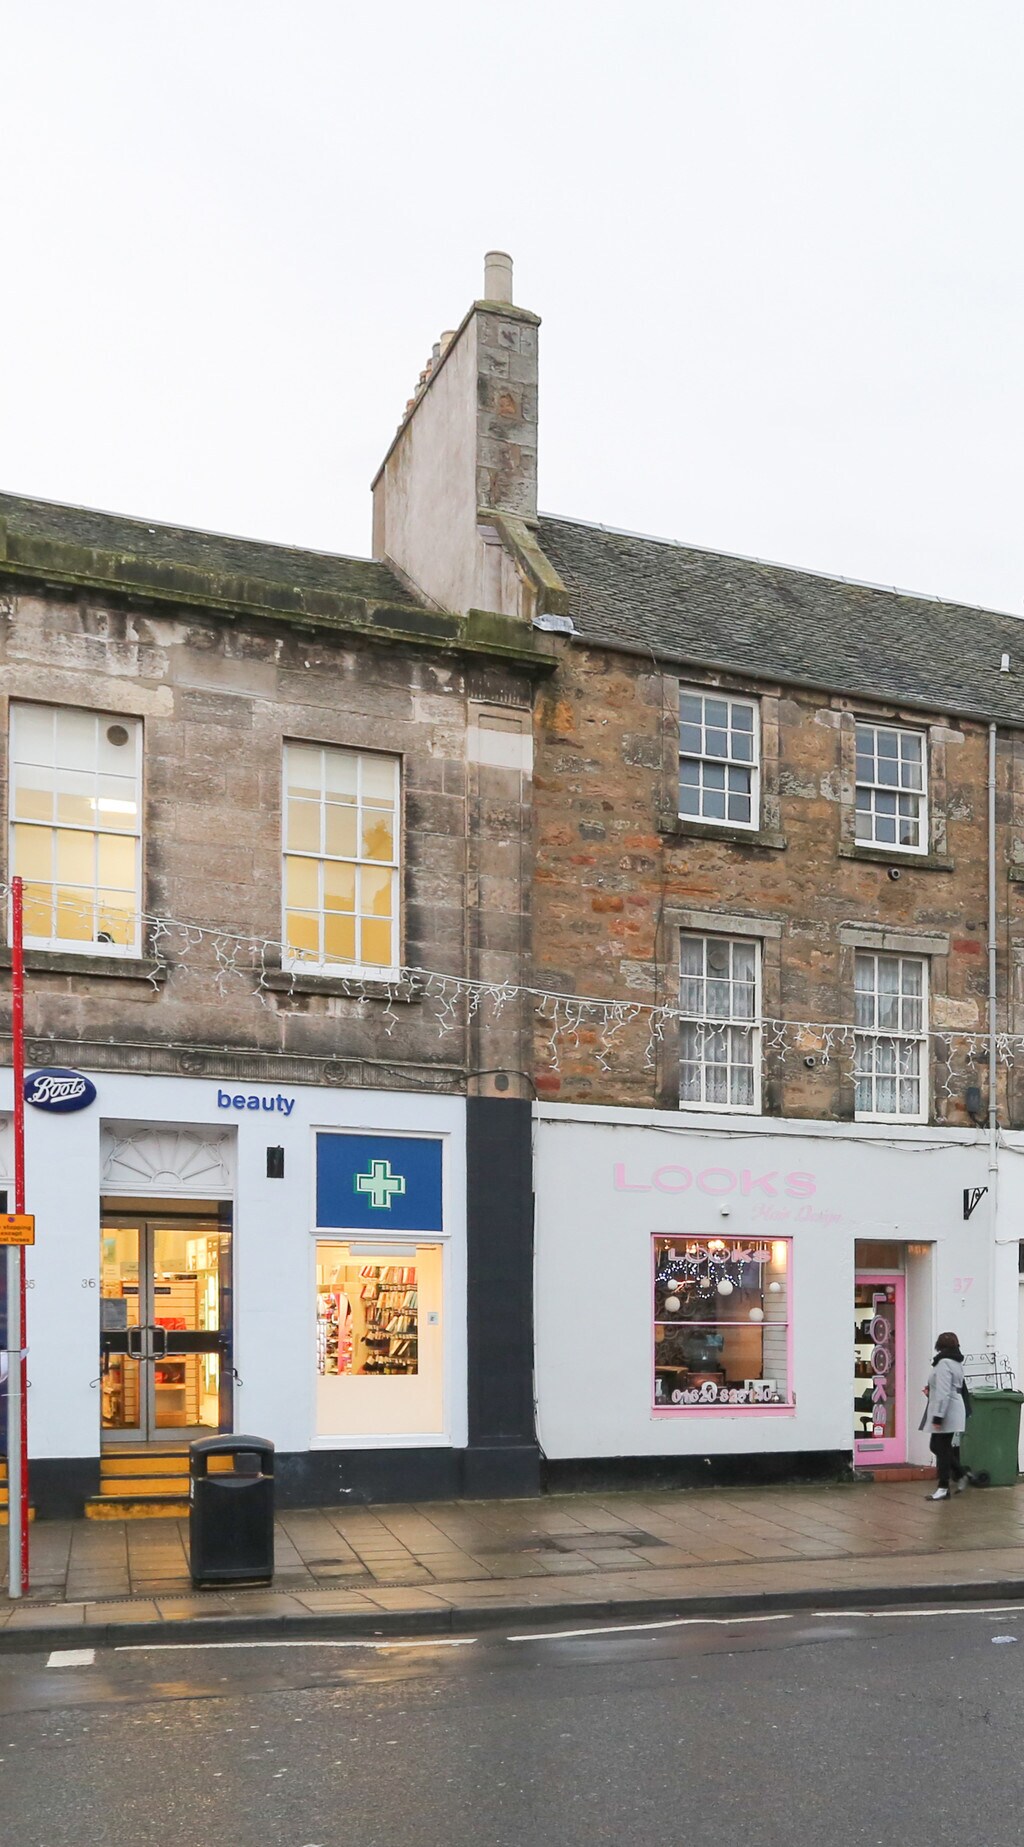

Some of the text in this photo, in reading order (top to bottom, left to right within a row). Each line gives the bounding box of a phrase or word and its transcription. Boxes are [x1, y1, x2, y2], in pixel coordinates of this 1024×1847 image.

[27, 1076, 86, 1103] Boots
[217, 1089, 295, 1116] beauty
[613, 1162, 817, 1199] LOOKS
[668, 1246, 771, 1264] LOOKS
[81, 1279, 96, 1289] 36
[953, 1278, 974, 1293] 37
